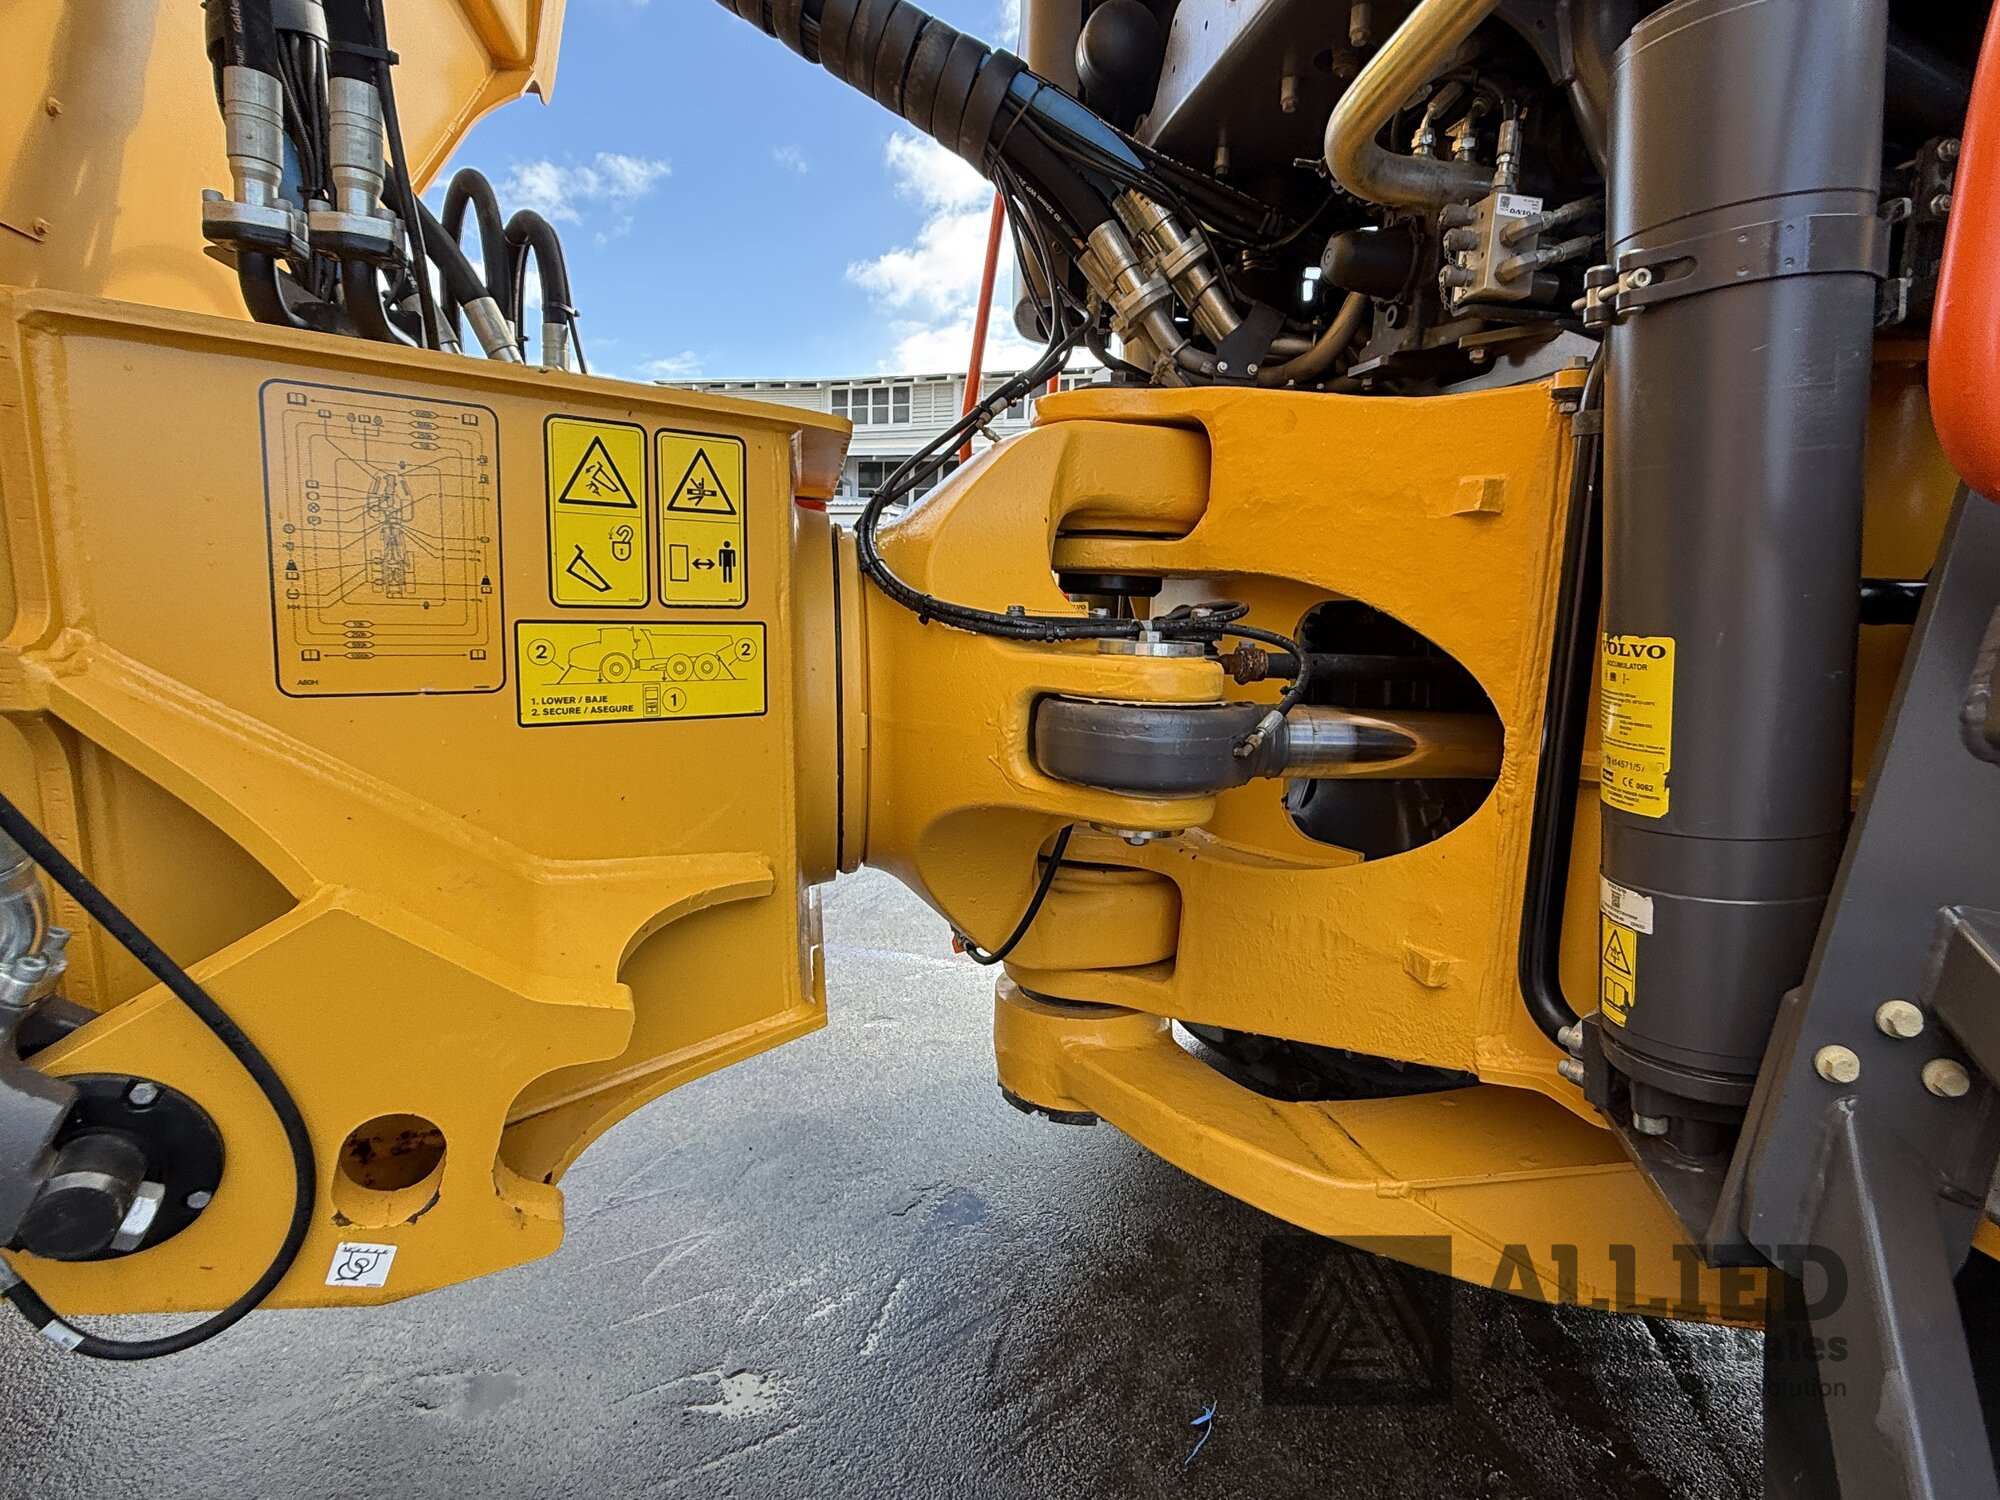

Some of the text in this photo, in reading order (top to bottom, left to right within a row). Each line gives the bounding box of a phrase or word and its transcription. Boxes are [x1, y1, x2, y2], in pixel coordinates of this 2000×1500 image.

[535, 644, 547, 659] 2
[740, 643, 751, 656] 2
[541, 696, 576, 705] LOWER
[585, 695, 608, 704] BAJE
[671, 694, 677, 706] 1
[542, 706, 581, 716] SECURE
[590, 704, 634, 714] ASEGURE
[1635, 782, 1654, 792] 0062
